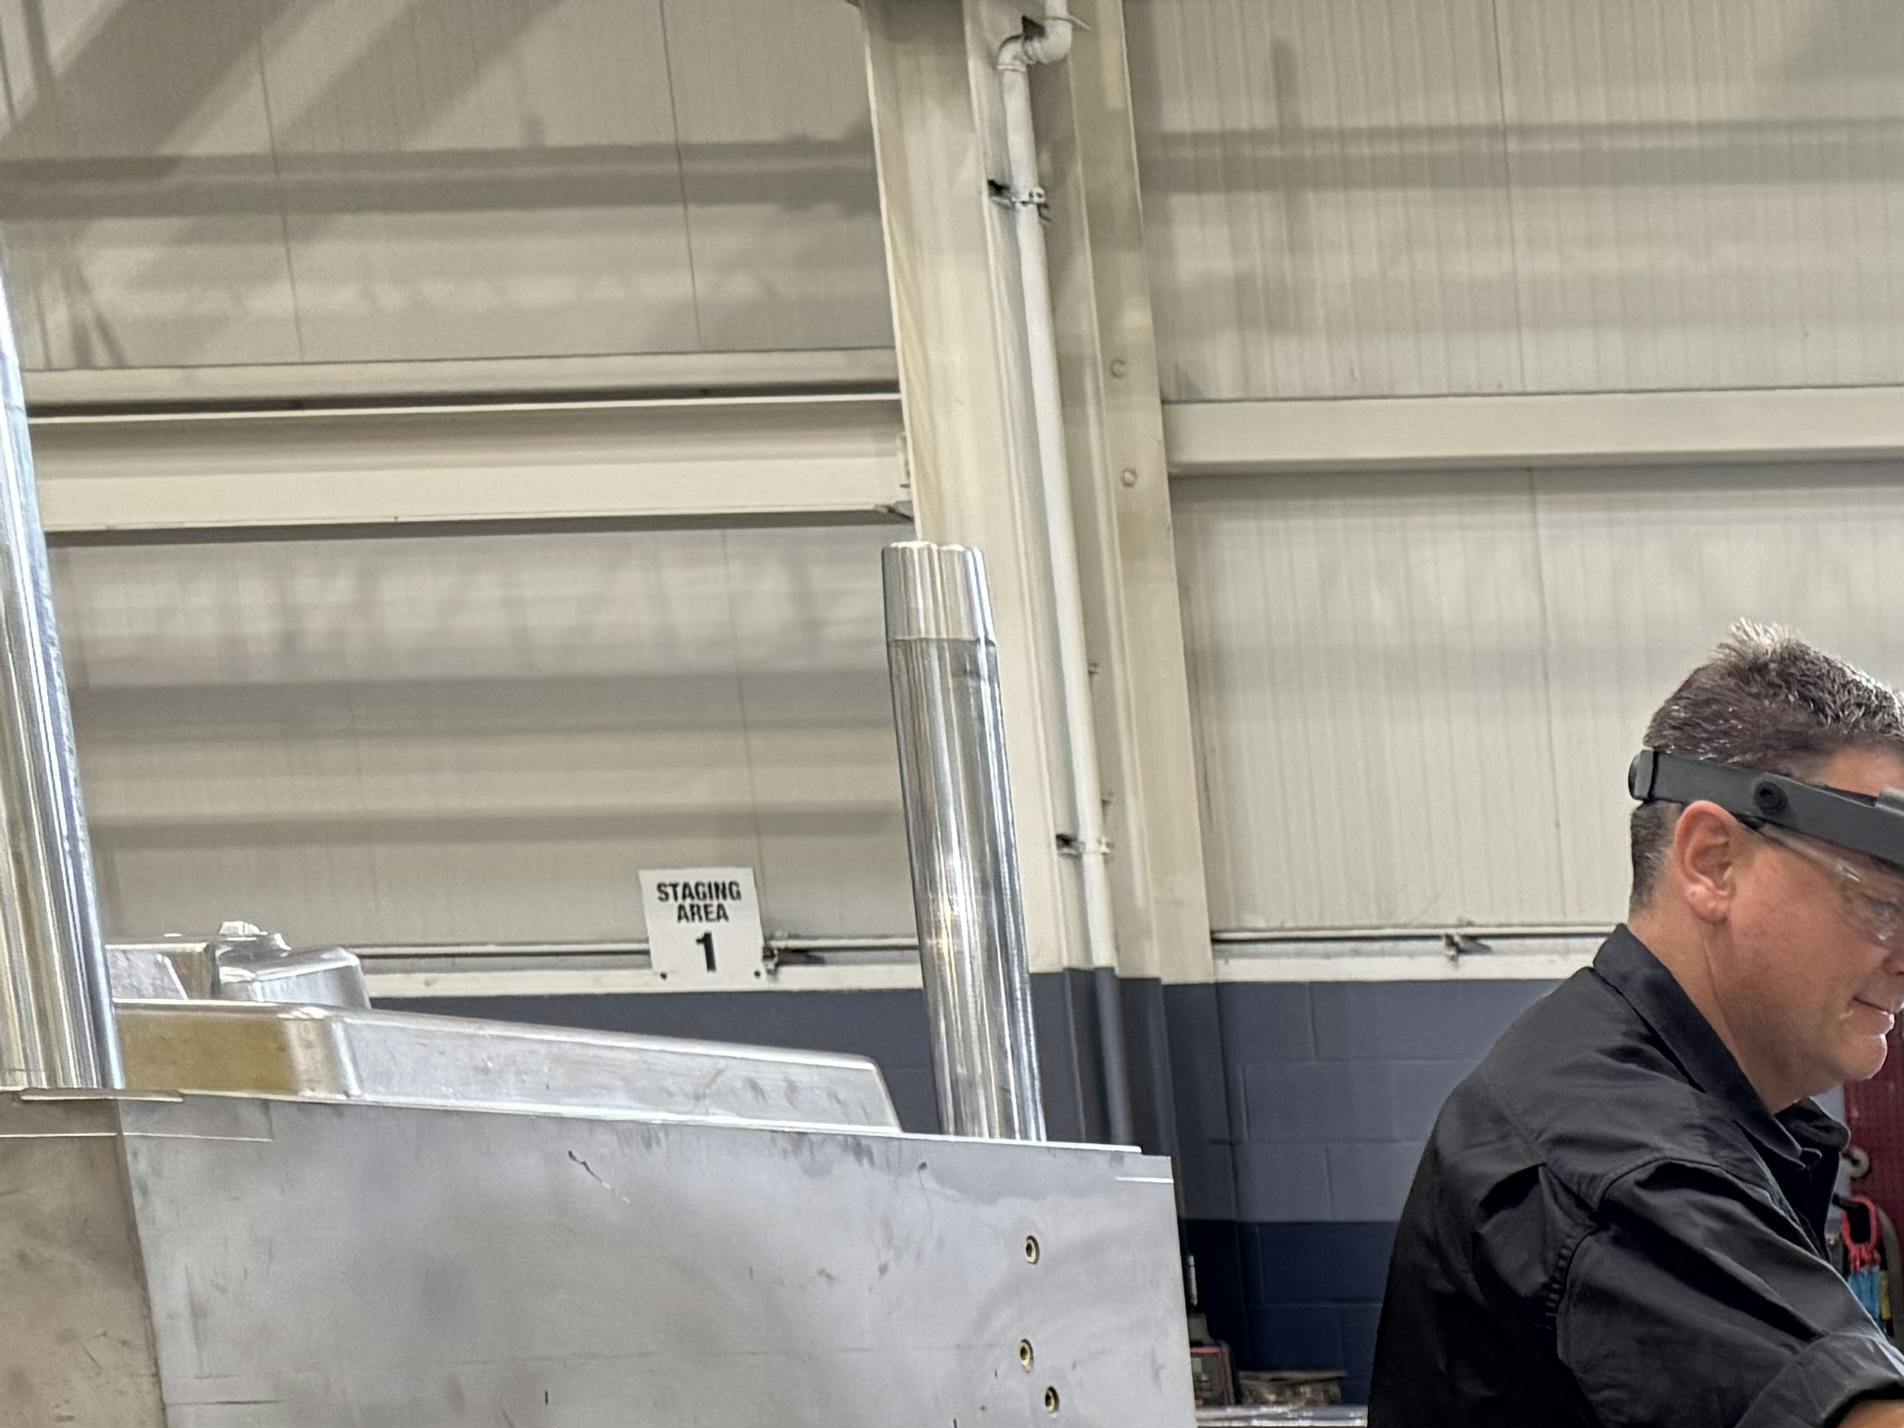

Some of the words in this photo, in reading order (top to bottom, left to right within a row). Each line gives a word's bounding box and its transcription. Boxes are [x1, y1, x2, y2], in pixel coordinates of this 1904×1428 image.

[656, 879, 742, 902] STAGING
[677, 903, 729, 923] AREA
[696, 932, 717, 973] 1
